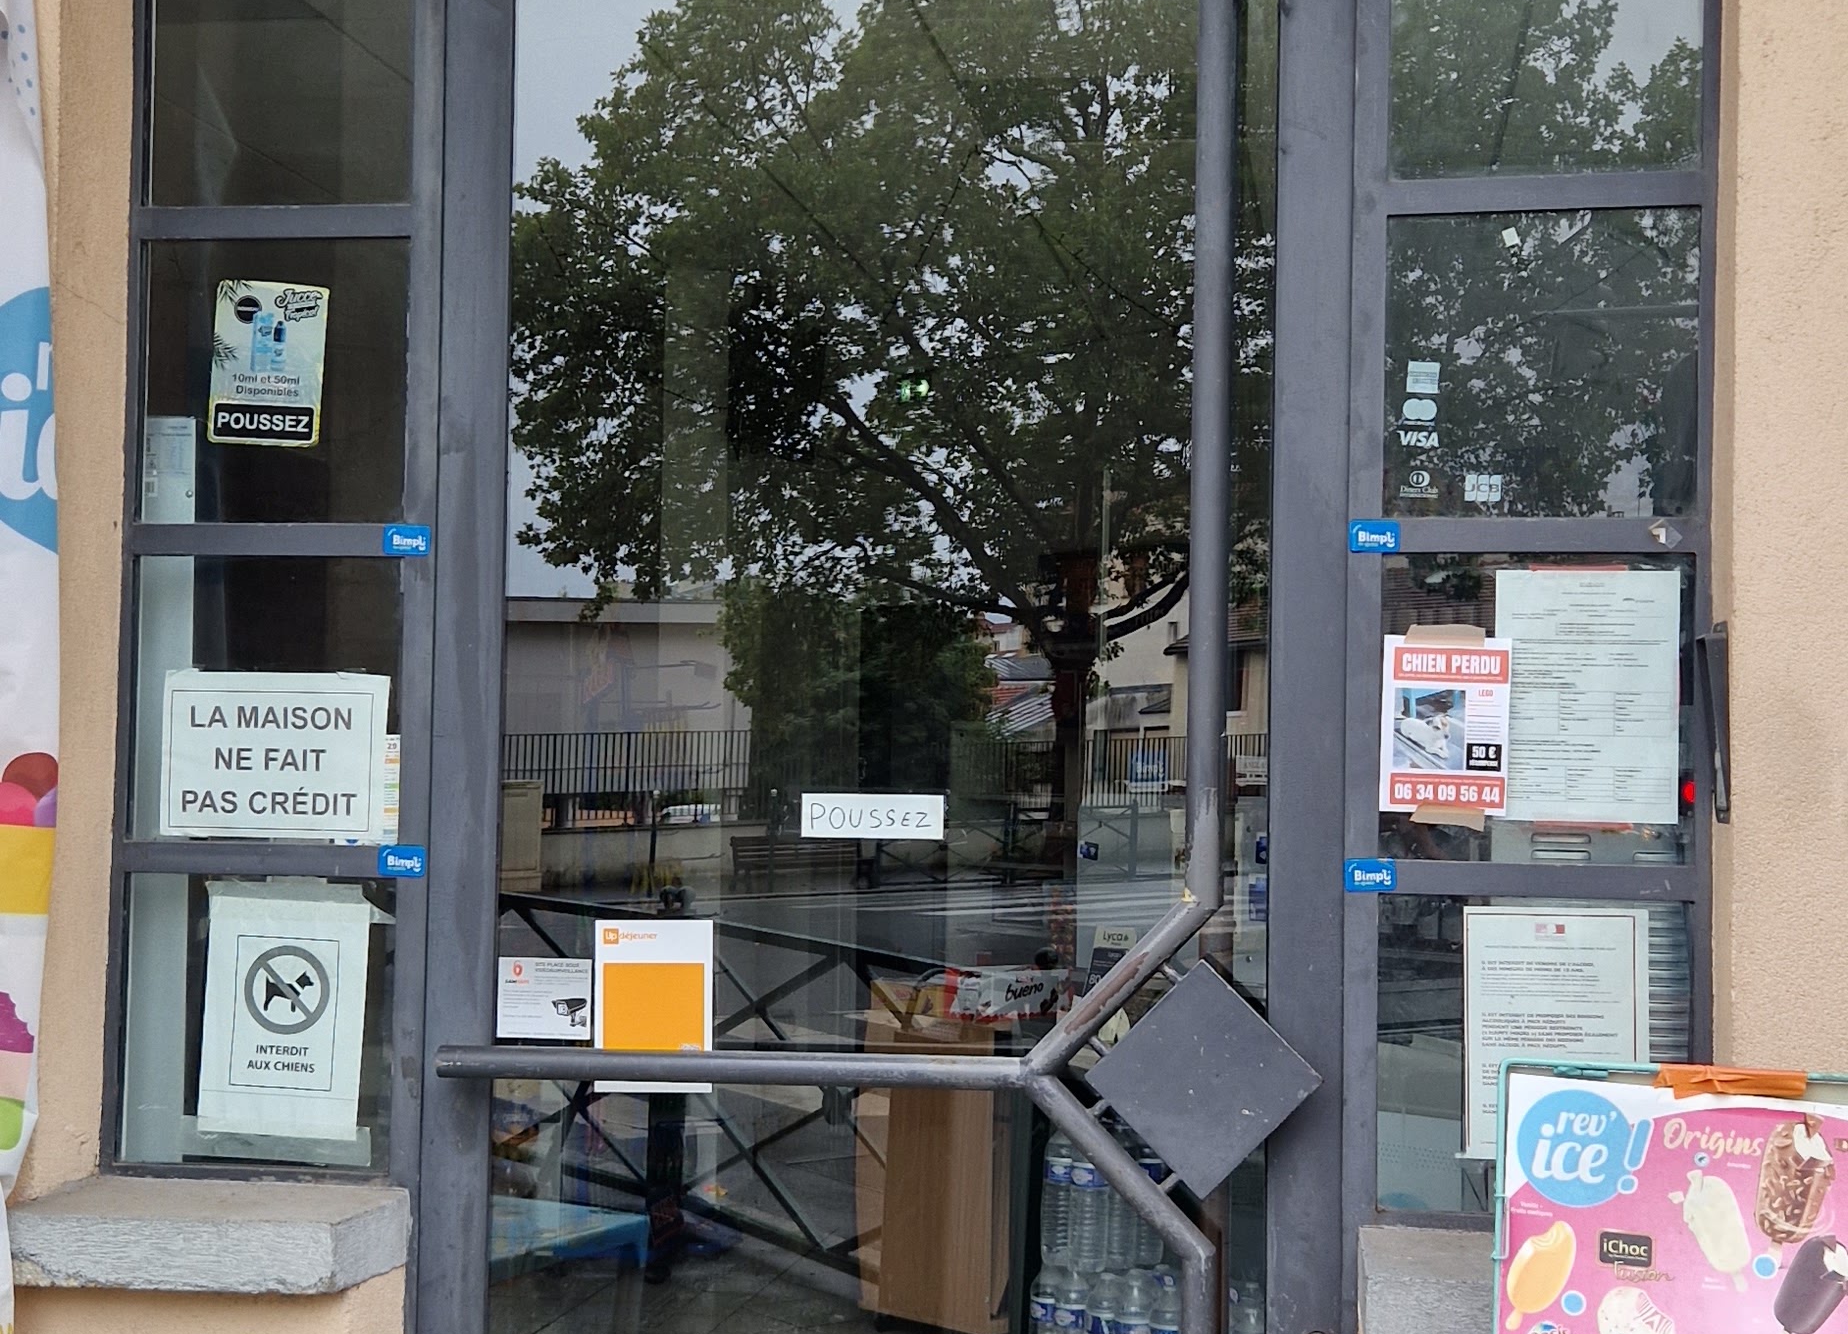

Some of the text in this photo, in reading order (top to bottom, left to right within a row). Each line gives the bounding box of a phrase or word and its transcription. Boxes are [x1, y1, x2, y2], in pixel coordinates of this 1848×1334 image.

[274, 375, 300, 386] 50ml
[236, 385, 299, 398] Disponibles
[216, 411, 310, 433] POUSSEZ
[1397, 430, 1440, 449] VISA
[1401, 652, 1502, 675] CHIEN PERDU
[188, 705, 354, 731] LA MAISON
[213, 747, 328, 772] NE FAIT
[1471, 745, 1497, 759] 50 €
[179, 786, 359, 817] PAS CRÉDIT
[1394, 783, 1500, 804] 06 34 09 56 44
[809, 802, 932, 830] POUSSEZ
[619, 929, 658, 942] déjeuner
[1103, 931, 1123, 942] Lyca
[1005, 982, 1044, 1002] bueno
[255, 1044, 309, 1057] INTERDIT
[247, 1060, 315, 1073] AUX CHIENS
[1663, 1117, 1764, 1159] Origins
[1603, 1238, 1649, 1257] iChoc
